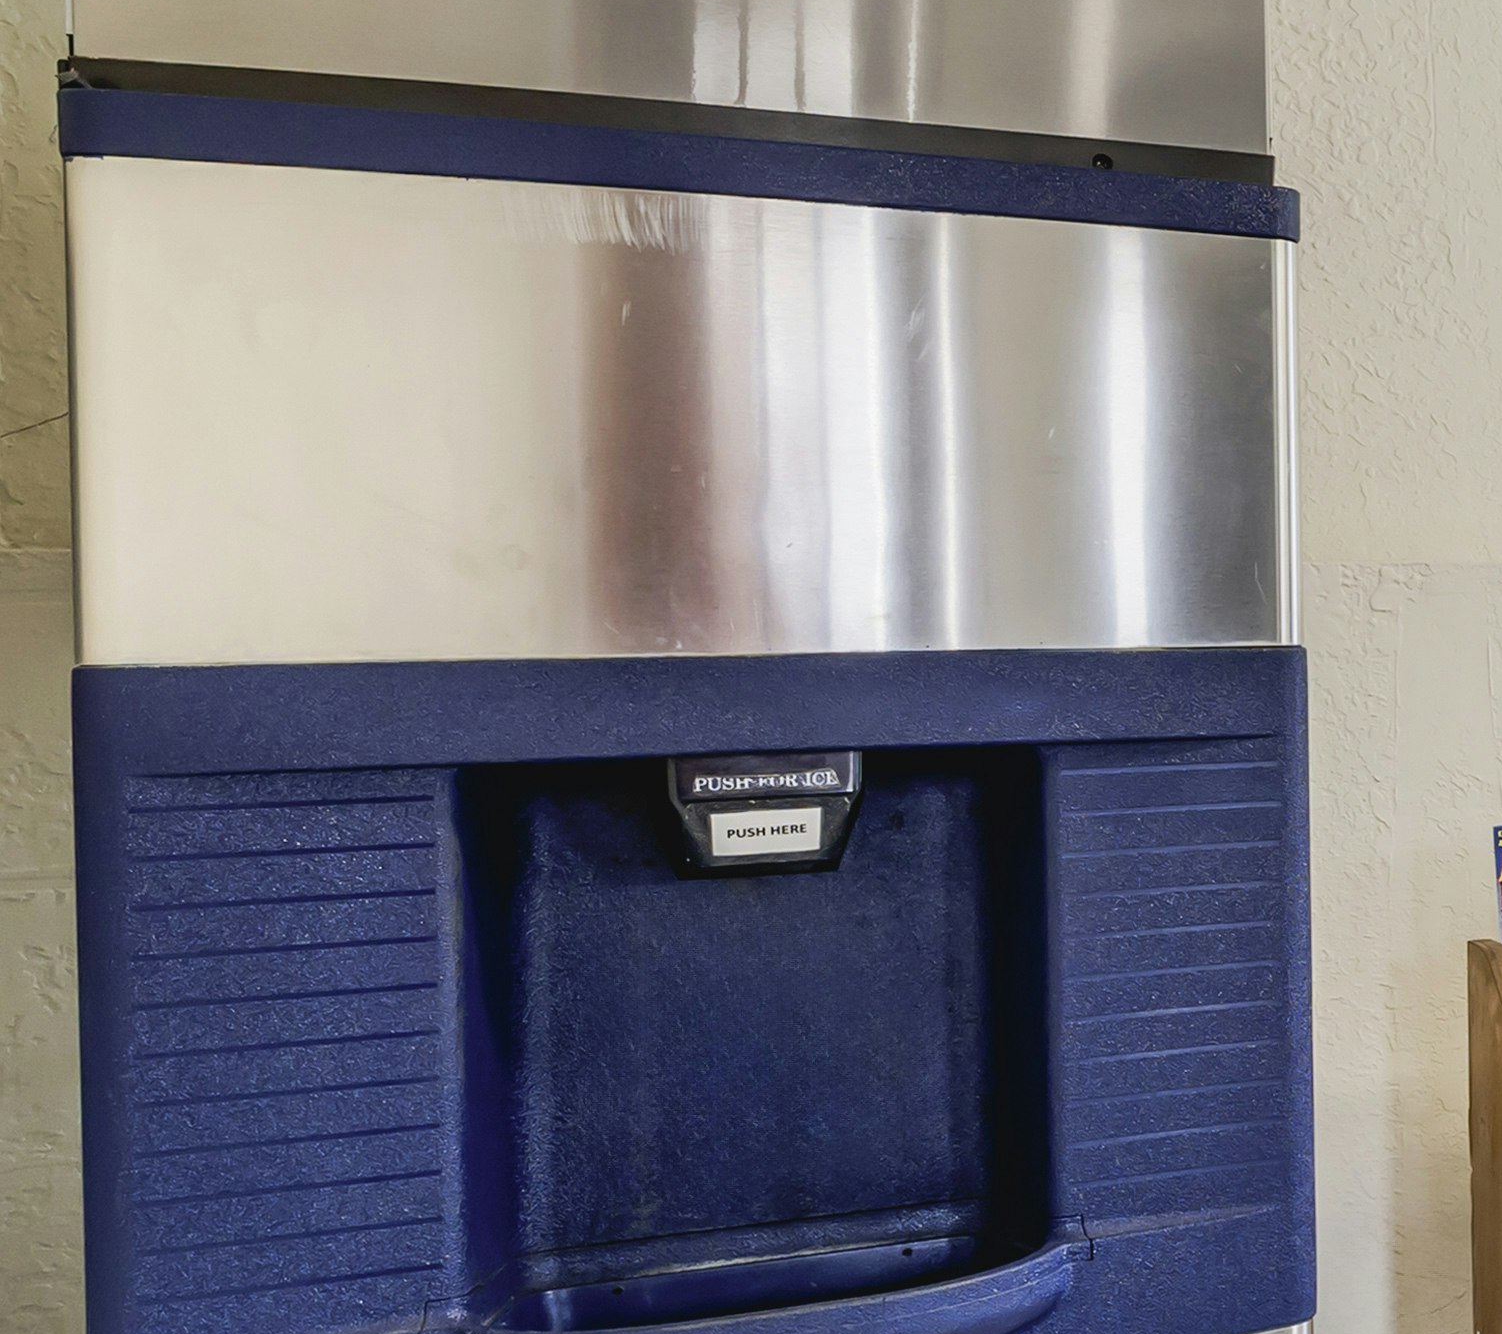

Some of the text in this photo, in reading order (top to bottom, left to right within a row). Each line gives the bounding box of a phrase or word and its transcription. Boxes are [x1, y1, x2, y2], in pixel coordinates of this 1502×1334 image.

[693, 776, 750, 792] PUSH
[727, 823, 807, 839] PUSH HERE
